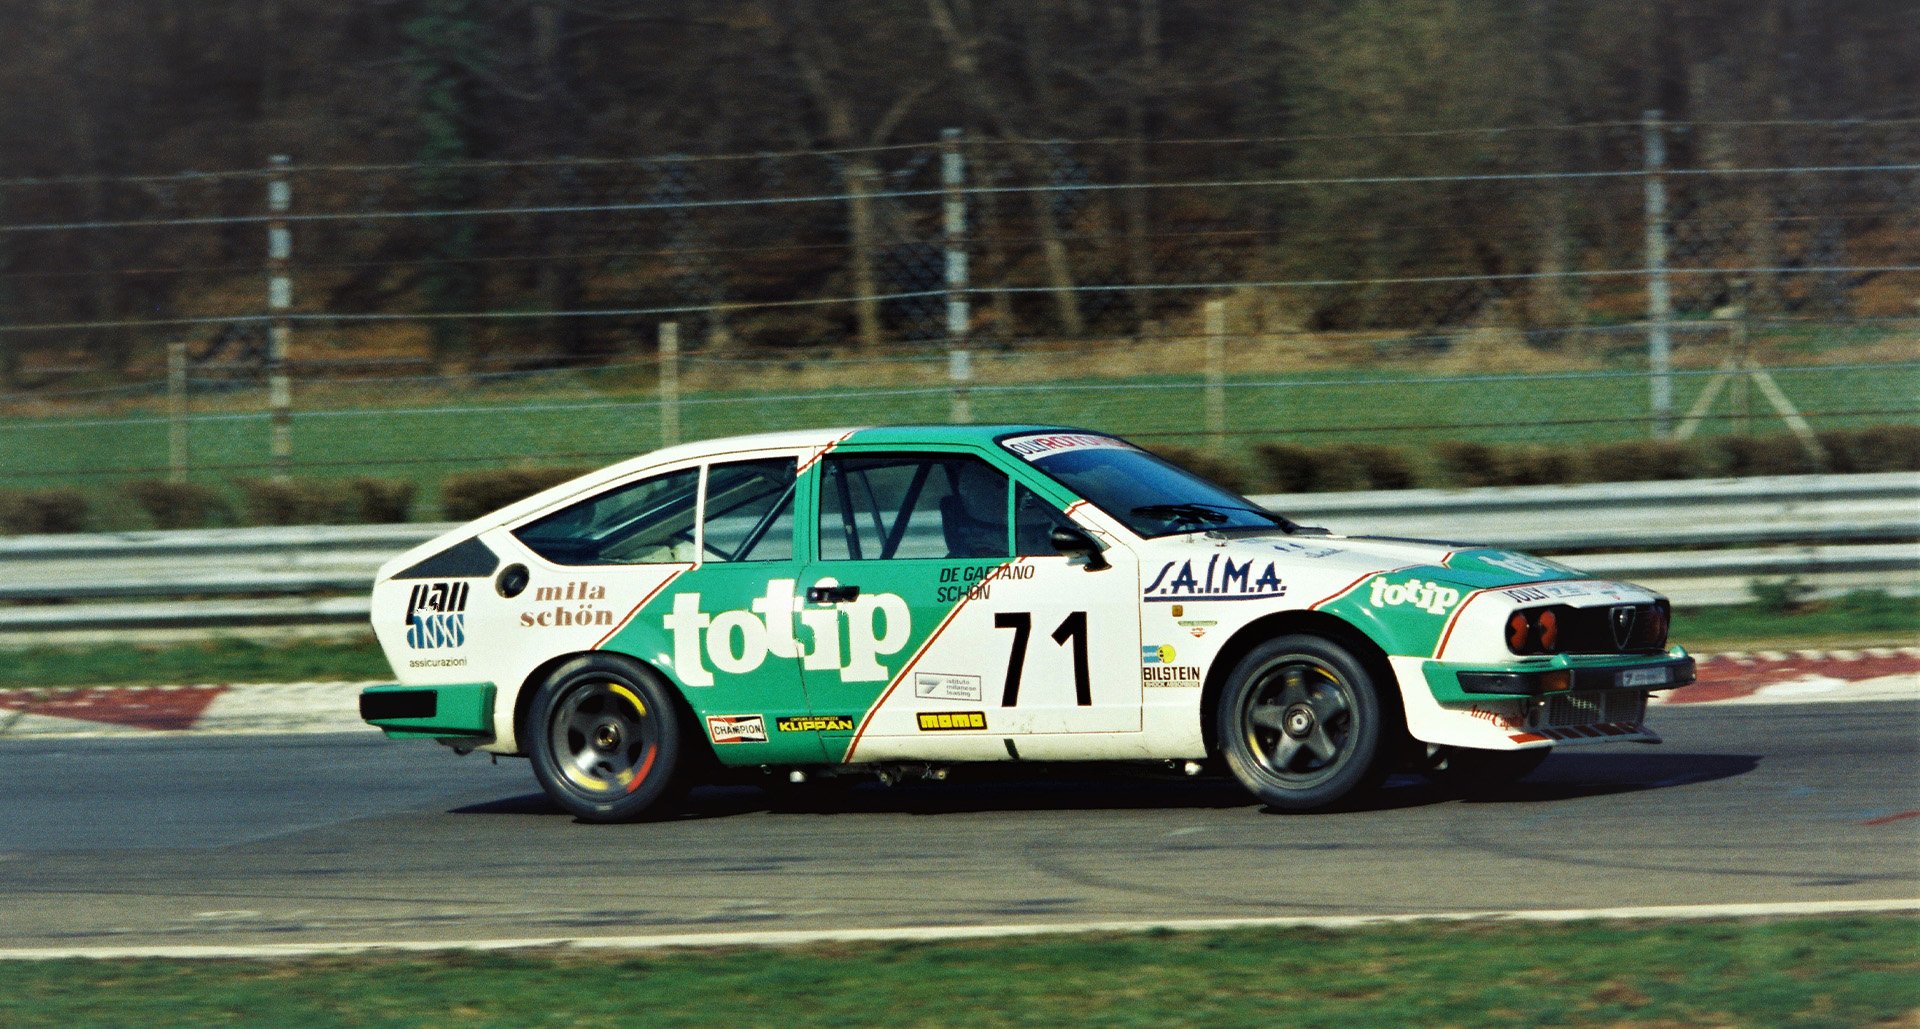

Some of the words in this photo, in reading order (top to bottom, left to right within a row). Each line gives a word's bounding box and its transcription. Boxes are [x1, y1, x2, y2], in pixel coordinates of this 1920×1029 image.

[940, 568, 959, 583] DE
[963, 565, 1035, 582] GAETANO
[535, 581, 606, 601] mila
[937, 582, 991, 603] SCHÖN
[1369, 576, 1459, 615] totip
[520, 604, 613, 627] schön
[663, 577, 911, 687] totip
[409, 658, 468, 668] assicurazioni
[994, 611, 1092, 707] 71
[1143, 667, 1200, 680] BILSTEIN
[714, 724, 761, 735] CHAMPION
[779, 720, 853, 732] KLIPPAN
